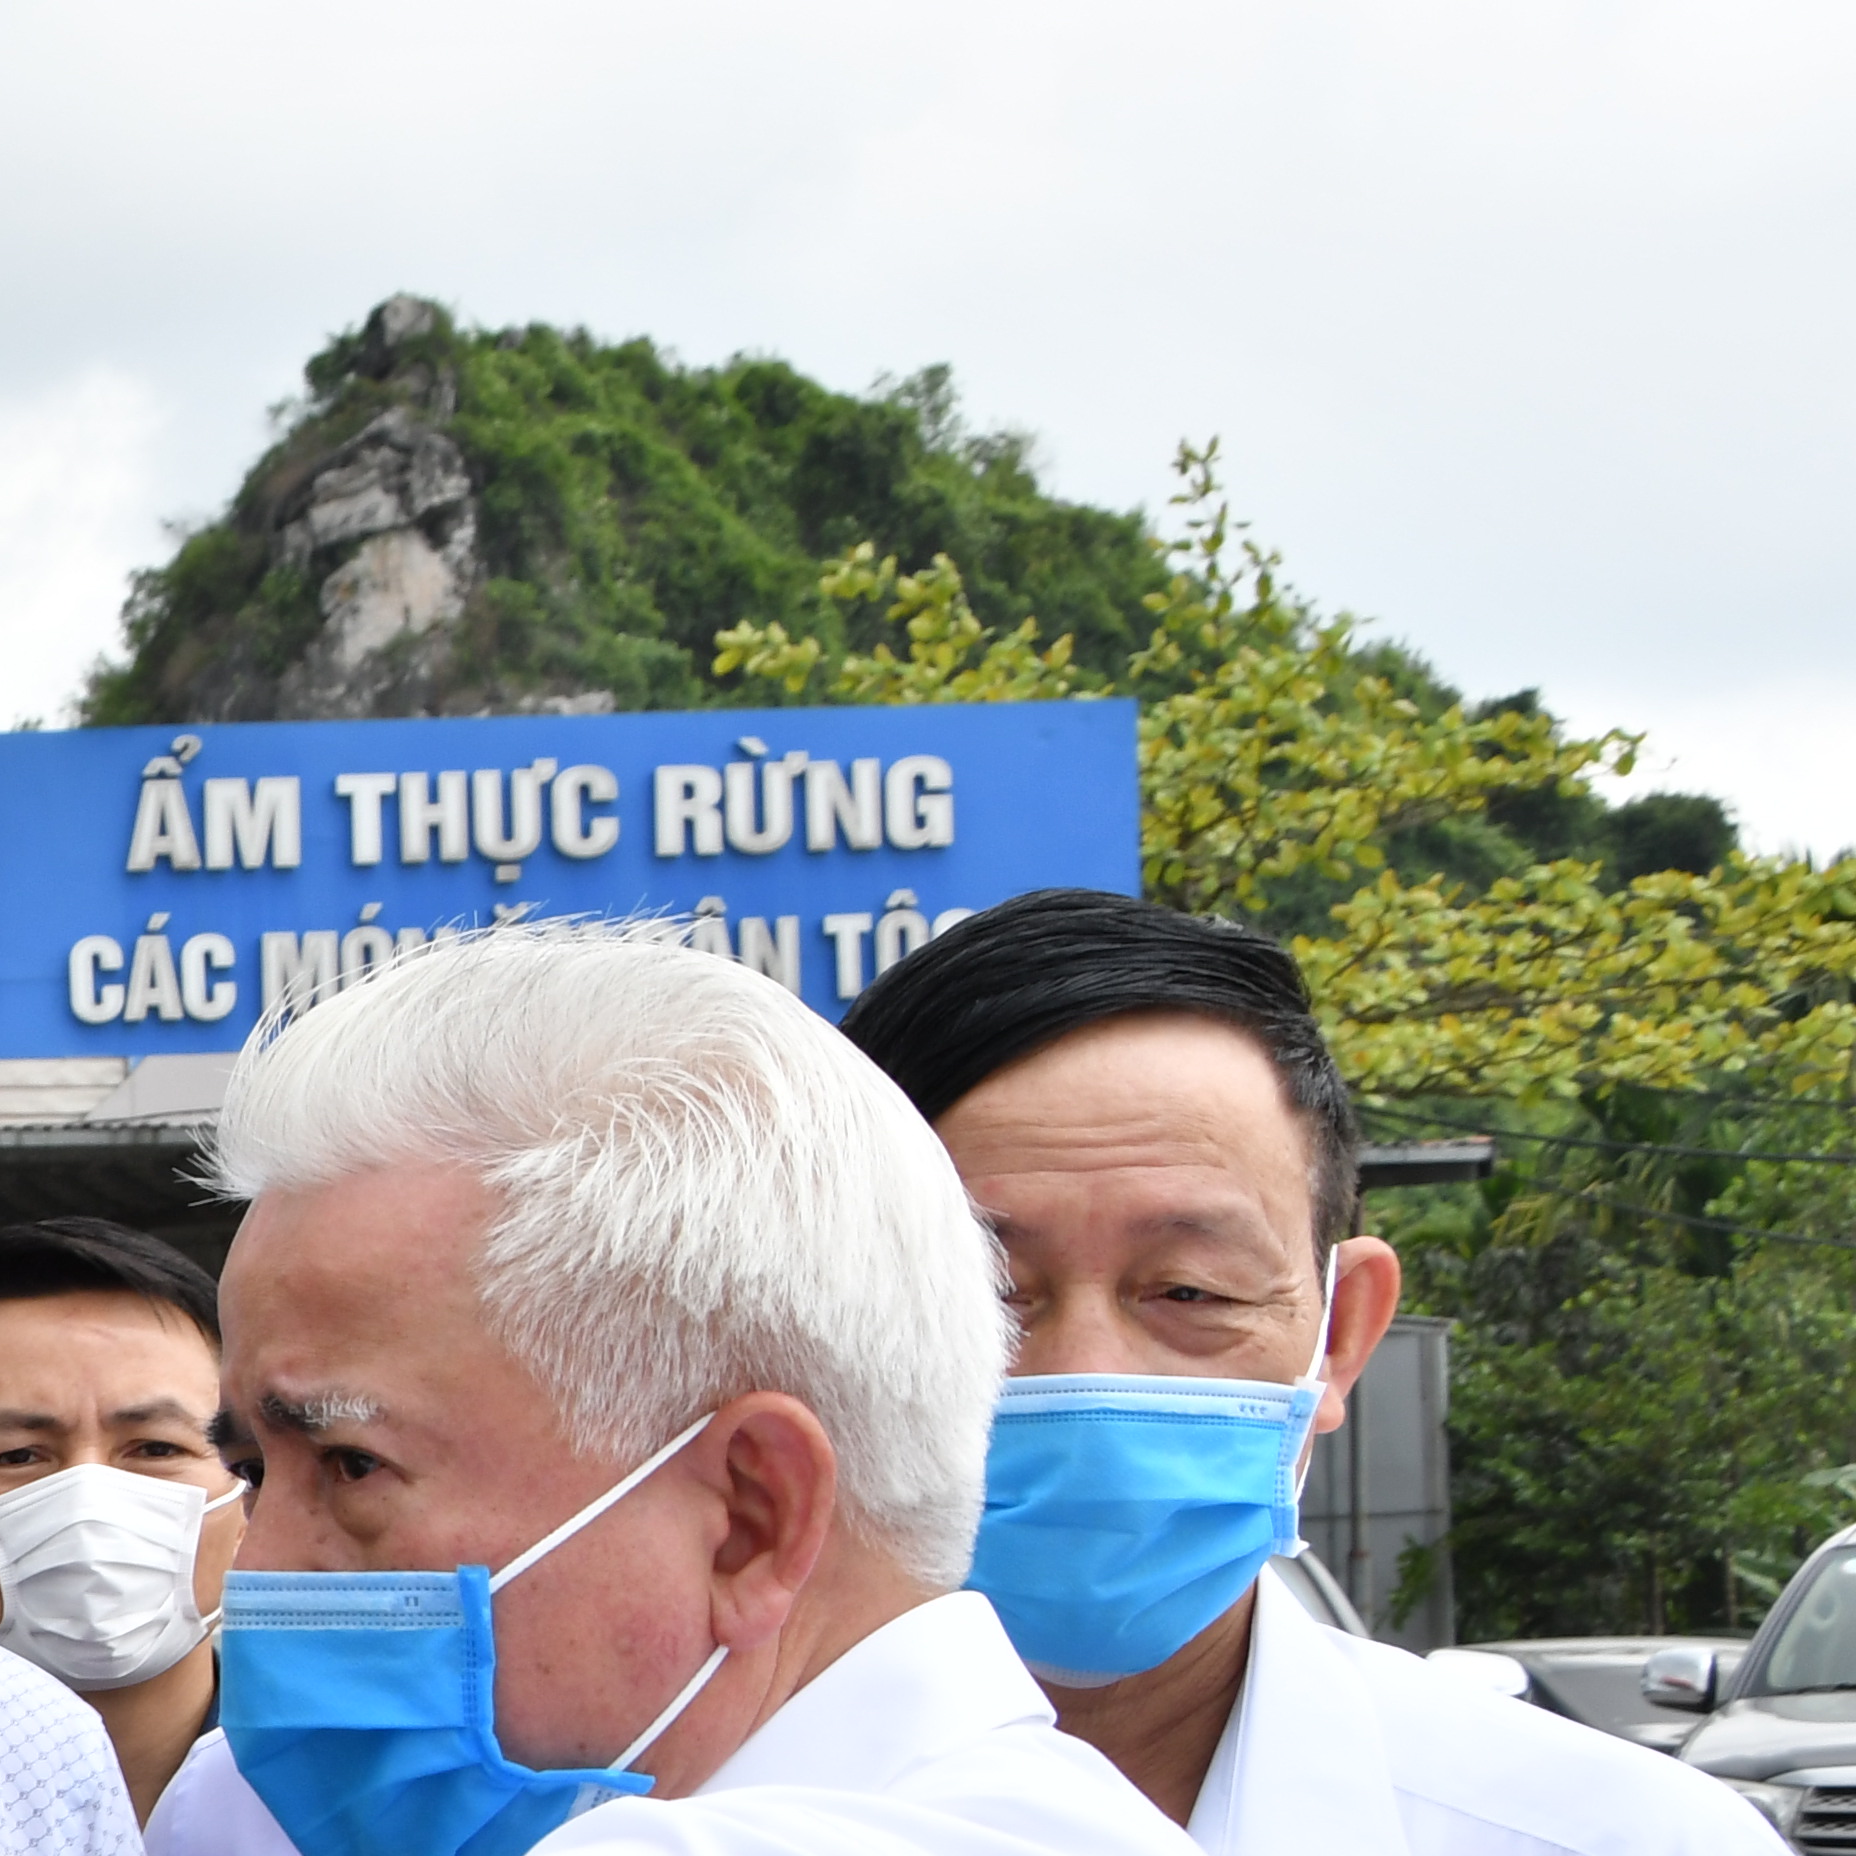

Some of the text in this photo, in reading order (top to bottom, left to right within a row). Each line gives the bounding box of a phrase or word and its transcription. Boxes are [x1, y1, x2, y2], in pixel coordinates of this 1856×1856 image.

[127, 734, 956, 882] ẨM THỰC RỪNG
[69, 911, 238, 1024] CÁC
